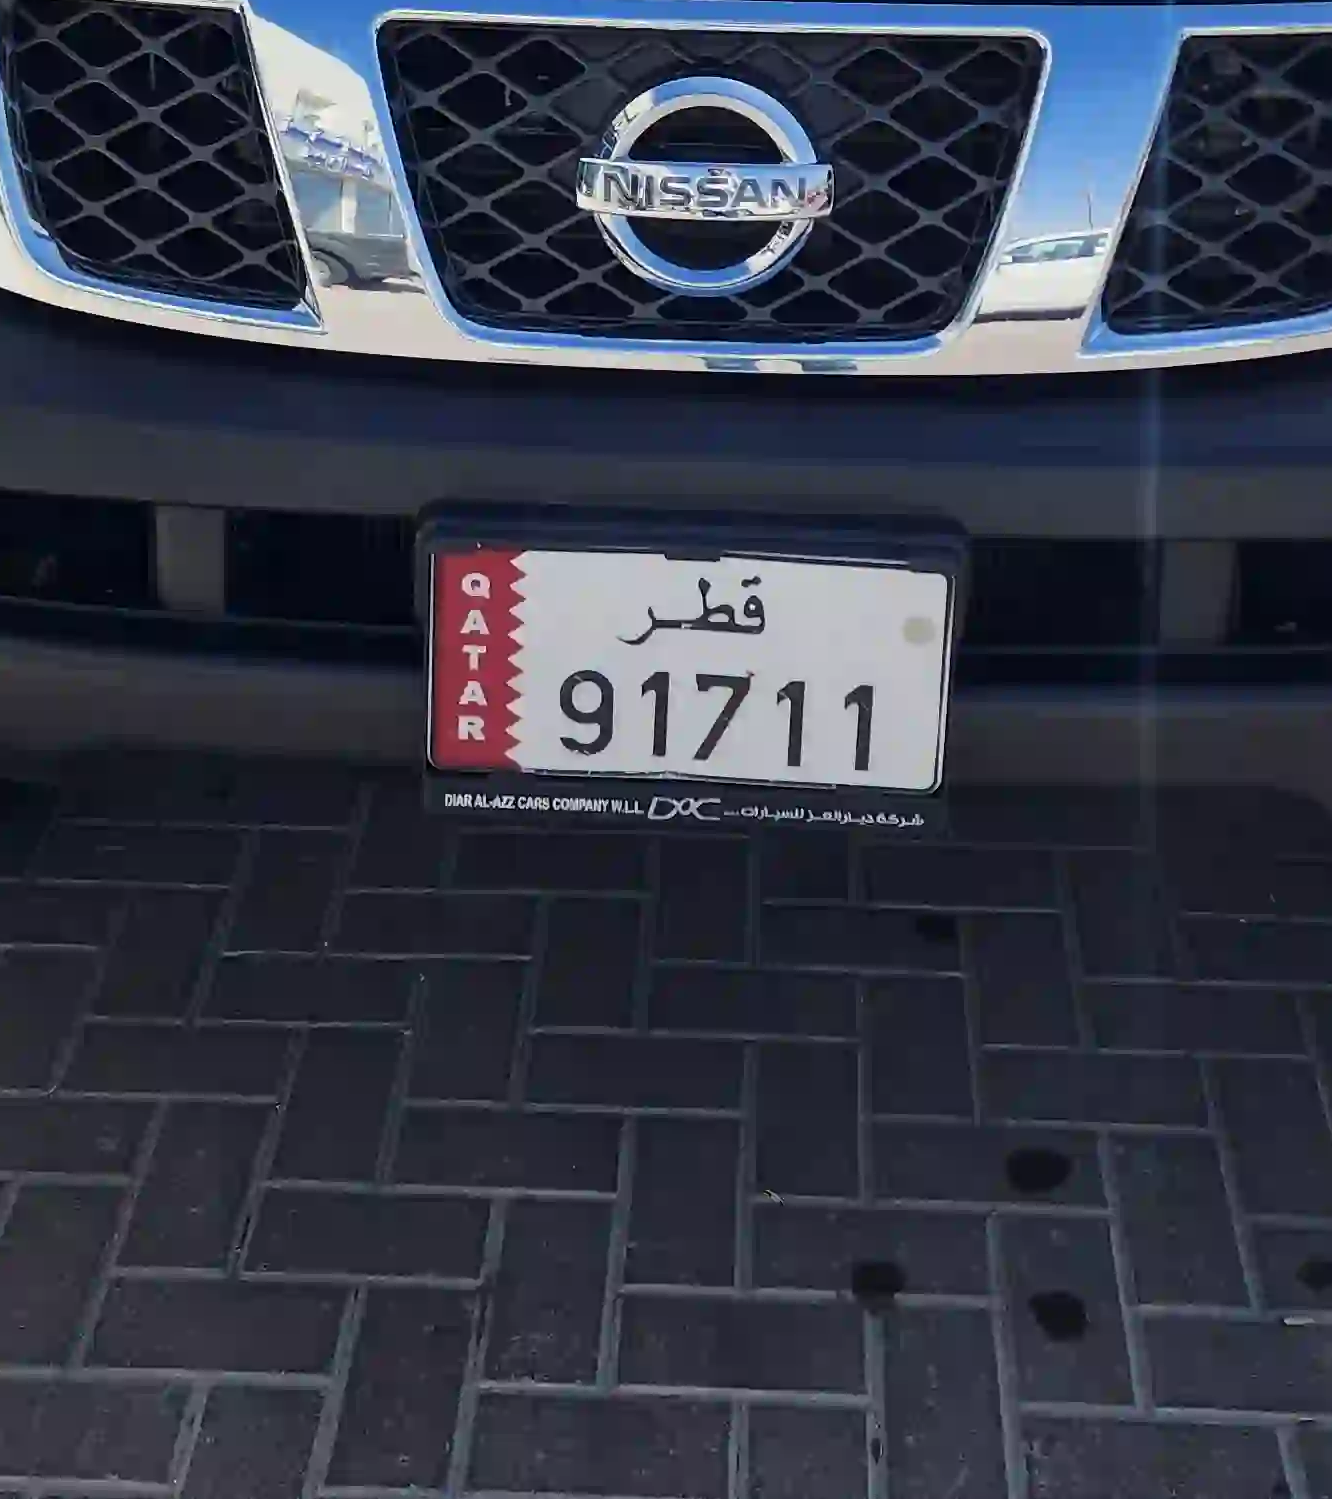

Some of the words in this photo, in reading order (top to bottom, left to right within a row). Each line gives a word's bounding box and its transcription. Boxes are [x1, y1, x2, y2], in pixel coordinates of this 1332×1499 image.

[602, 170, 807, 209] NISSAN
[615, 574, 766, 646] قطر
[457, 571, 491, 741] QATAR
[559, 669, 874, 771] 91711
[444, 792, 472, 808] DIAR
[474, 793, 515, 809] AL-AZZ
[517, 795, 550, 811] CARS
[552, 797, 609, 814] COMPANY
[876, 812, 925, 828] شركة
